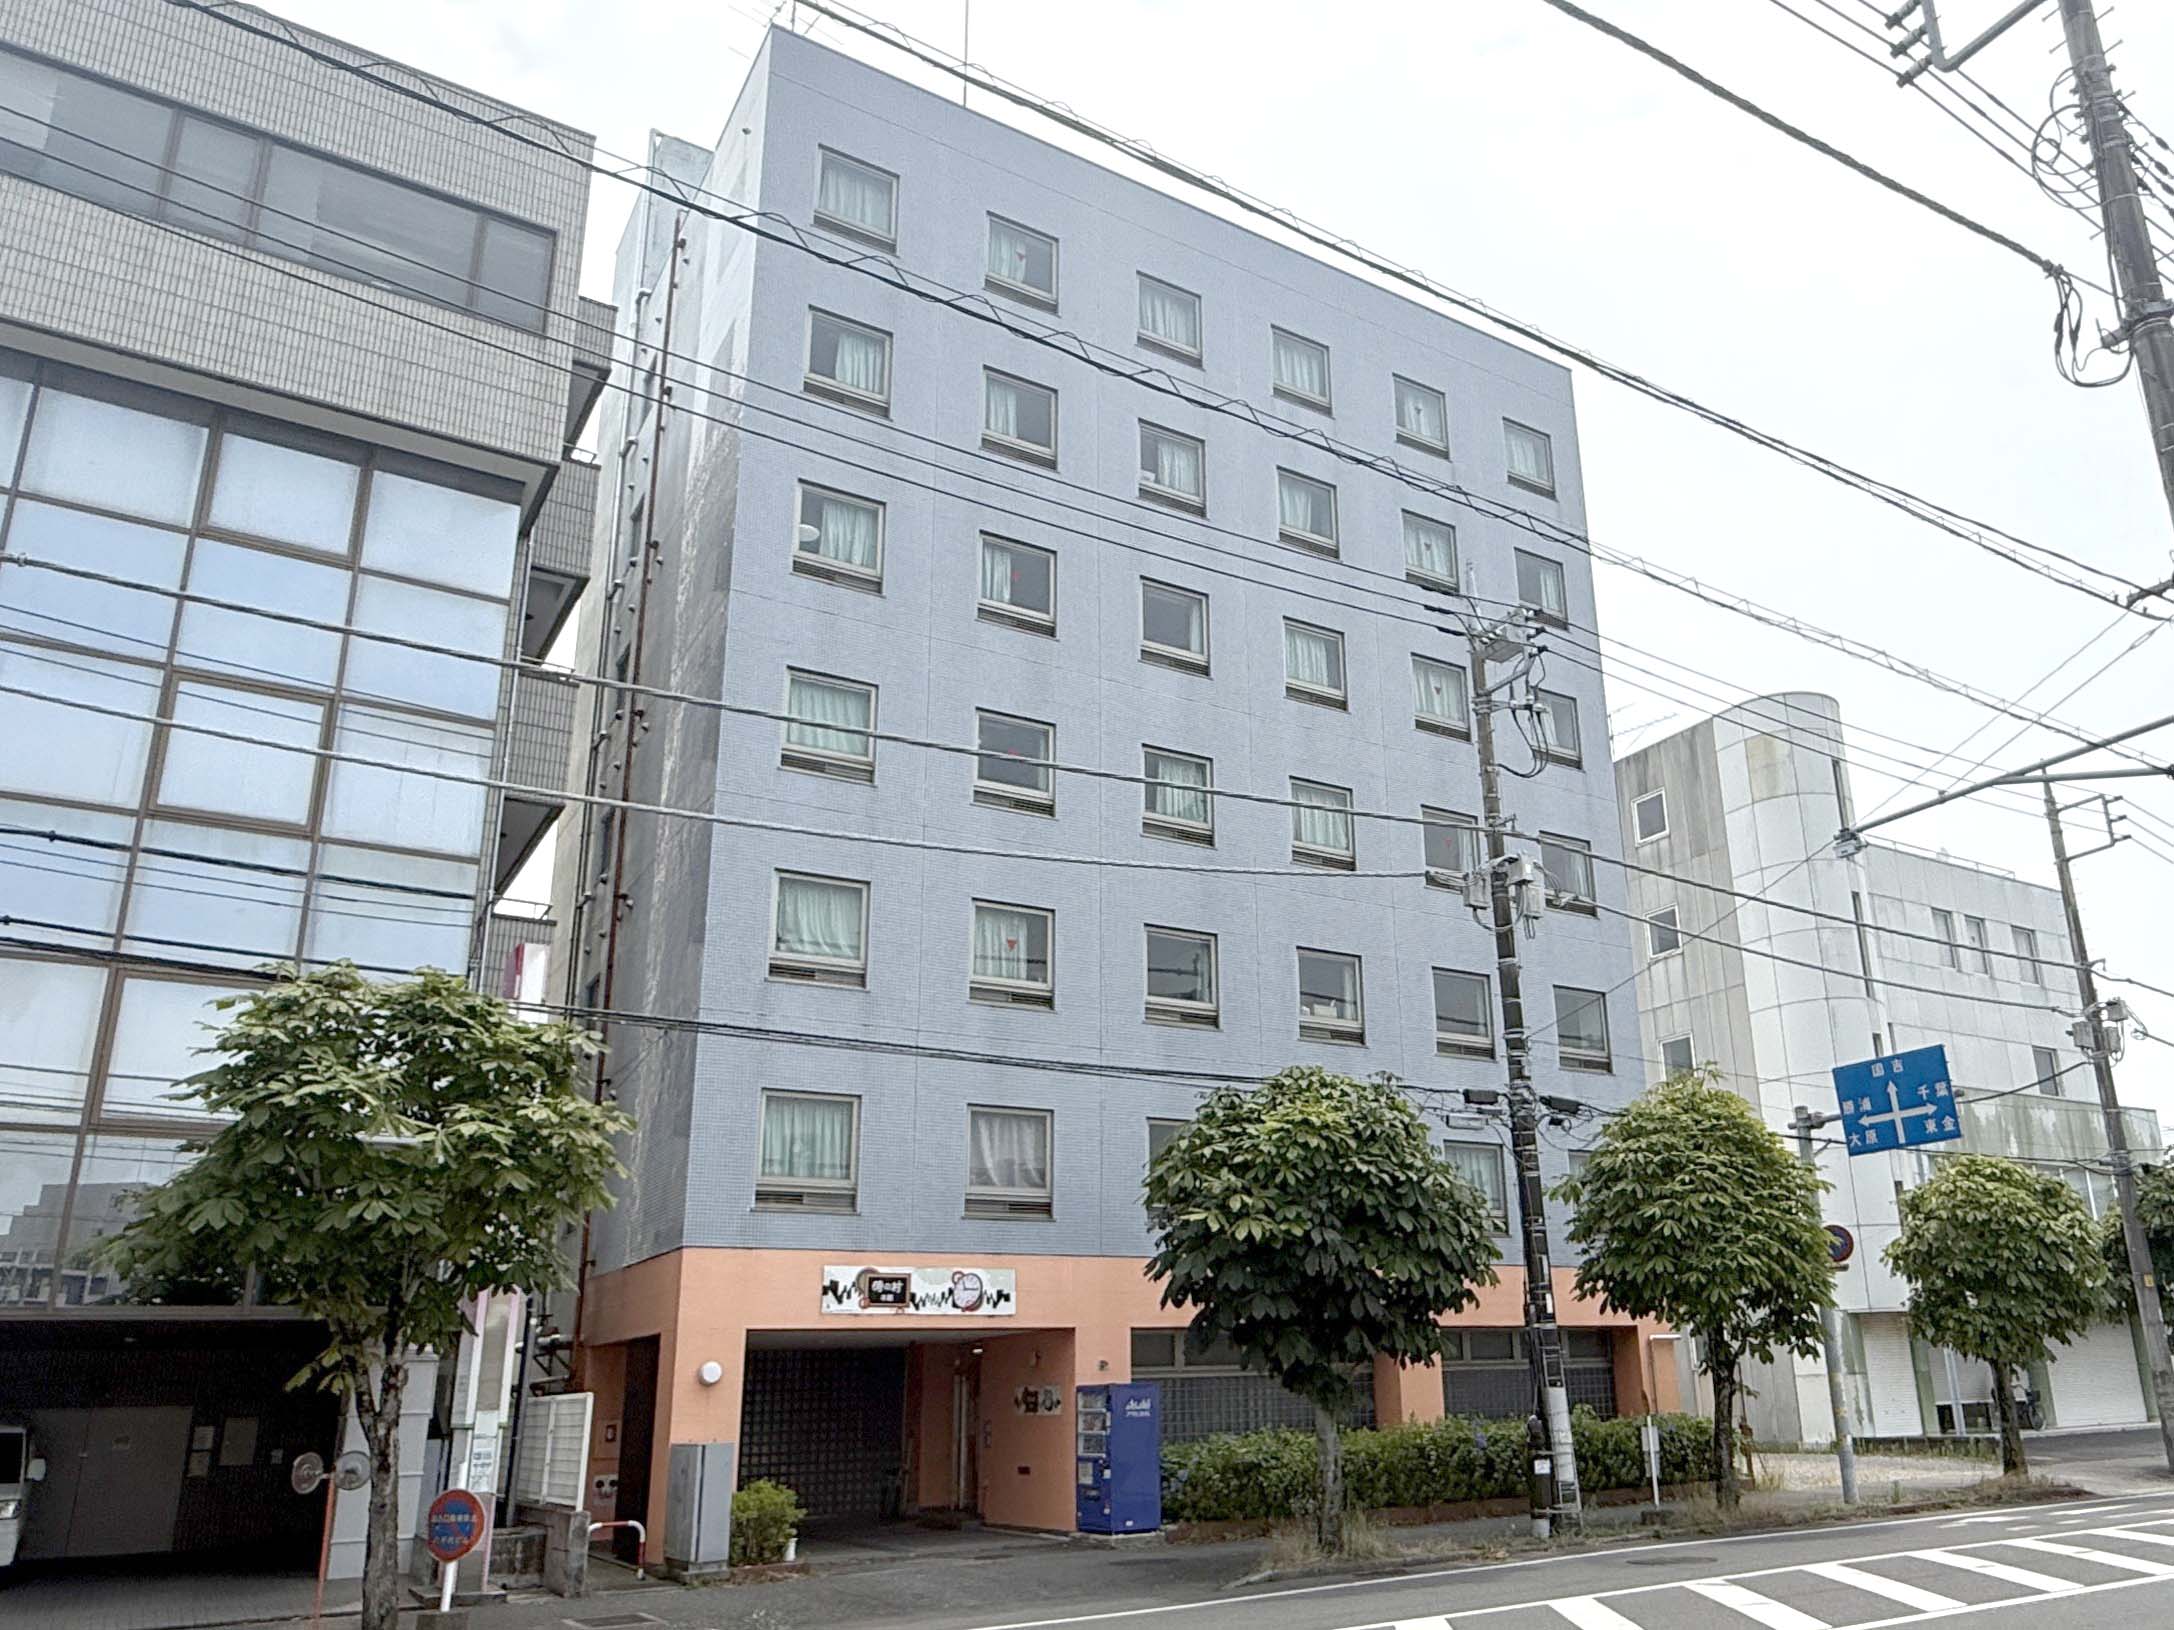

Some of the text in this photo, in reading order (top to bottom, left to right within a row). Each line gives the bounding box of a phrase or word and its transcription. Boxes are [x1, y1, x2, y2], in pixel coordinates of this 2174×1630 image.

[1917, 1080, 1949, 1101] 千葉
[1842, 1096, 1873, 1115] 勝浦
[1925, 1114, 1957, 1134] 東金
[1848, 1128, 1879, 1147] 大原
